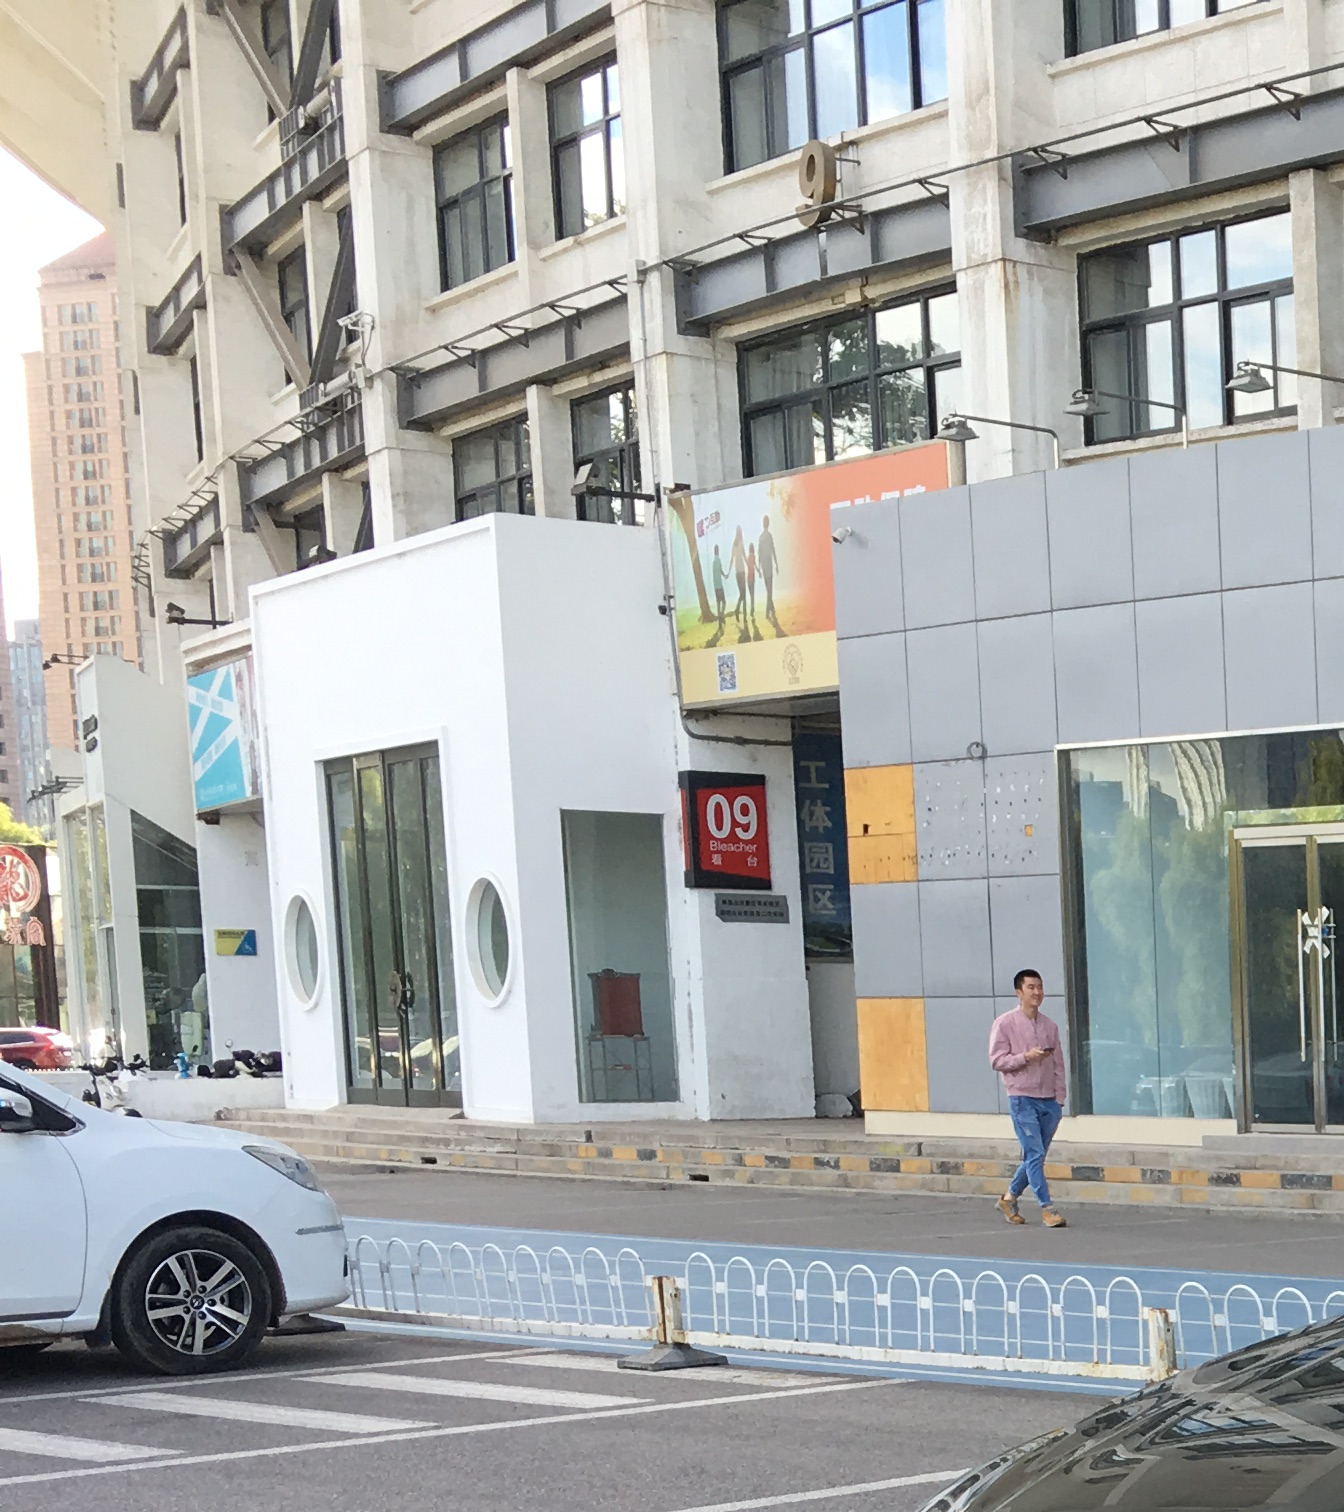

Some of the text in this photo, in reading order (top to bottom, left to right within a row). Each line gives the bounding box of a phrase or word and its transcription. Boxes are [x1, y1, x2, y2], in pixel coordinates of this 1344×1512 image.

[795, 139, 830, 227] 9
[706, 793, 758, 840] 09
[709, 839, 757, 852] Bleacher
[799, 760, 838, 915] 工体园区
